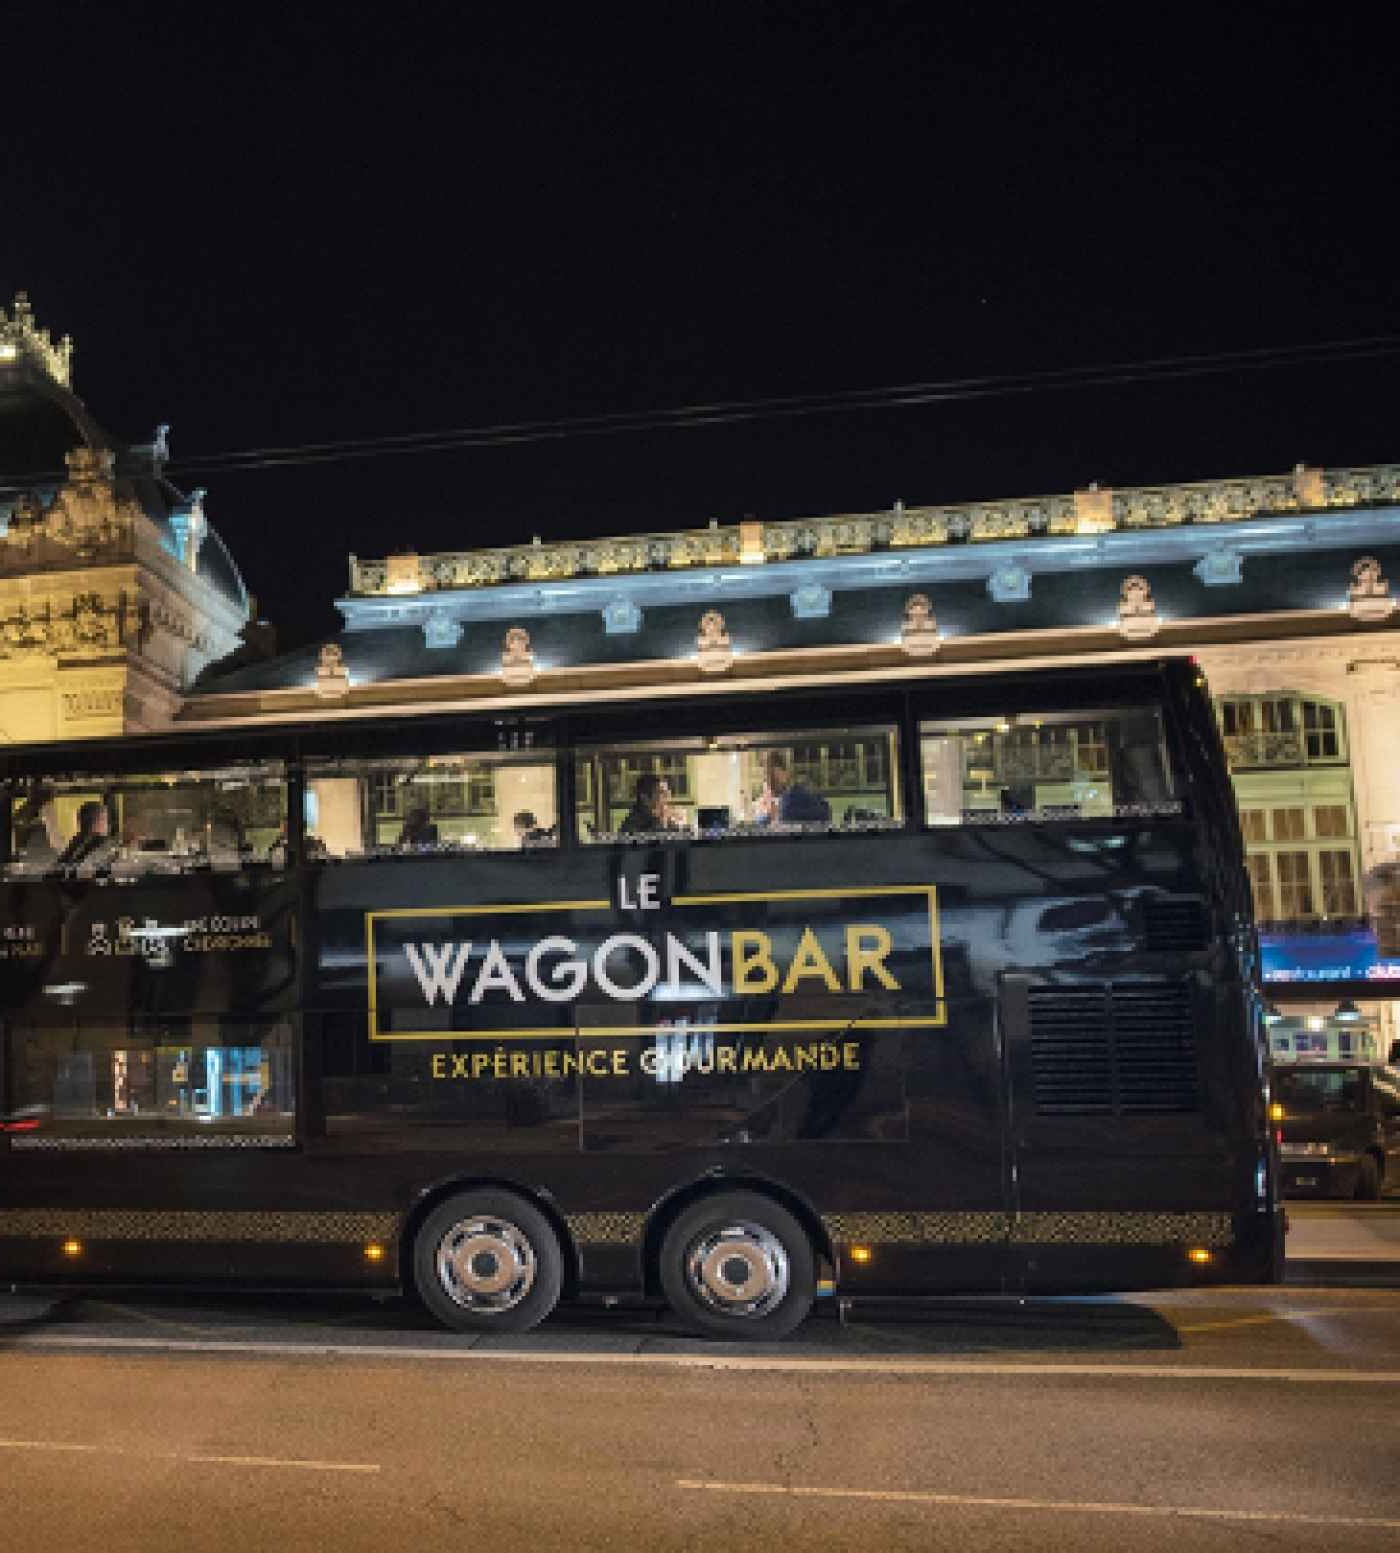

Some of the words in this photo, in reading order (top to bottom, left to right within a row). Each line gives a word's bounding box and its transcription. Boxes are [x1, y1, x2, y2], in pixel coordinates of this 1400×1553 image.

[618, 873, 661, 910] LE
[402, 924, 902, 1007] WAGONBAR
[432, 1046, 630, 1079] EXPÉRIENCE
